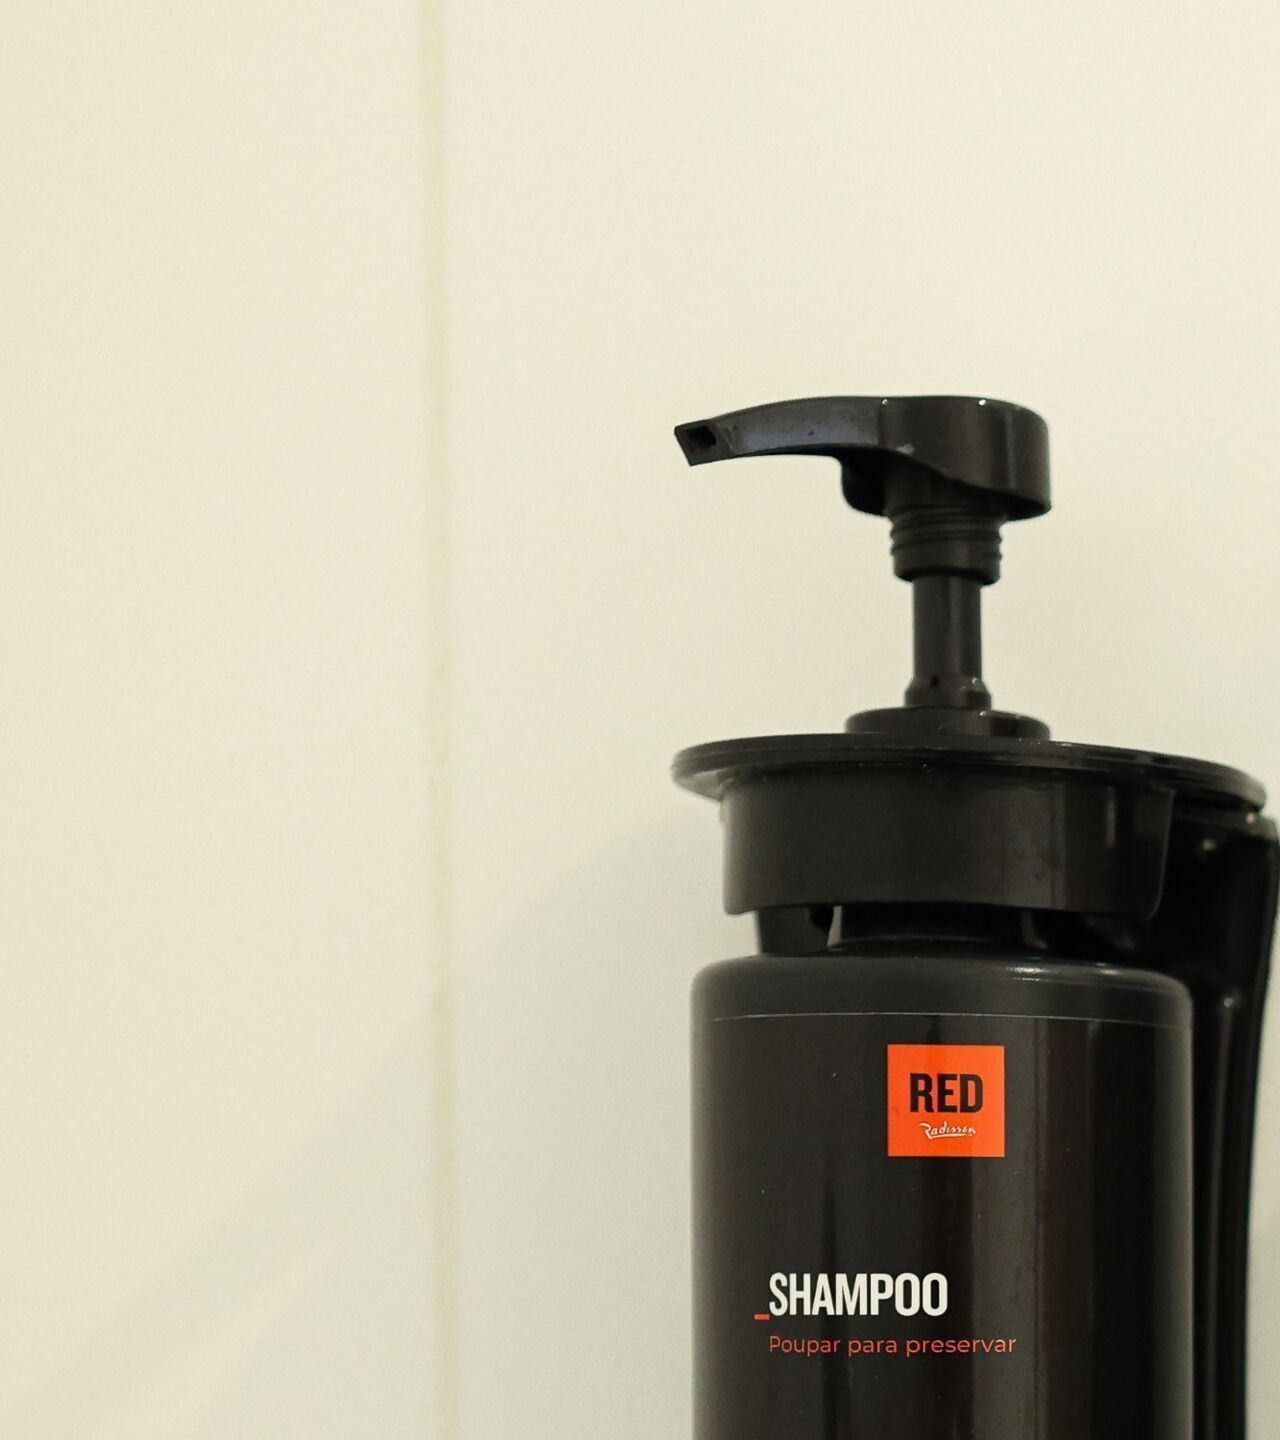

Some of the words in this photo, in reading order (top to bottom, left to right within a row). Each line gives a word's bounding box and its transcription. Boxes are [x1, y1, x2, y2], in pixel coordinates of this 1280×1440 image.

[909, 1072, 984, 1113] RED
[769, 1272, 948, 1317] SHAMPOO
[769, 1336, 841, 1356] Poupar
[848, 1339, 897, 1356] para
[906, 1337, 1017, 1357] preservar
